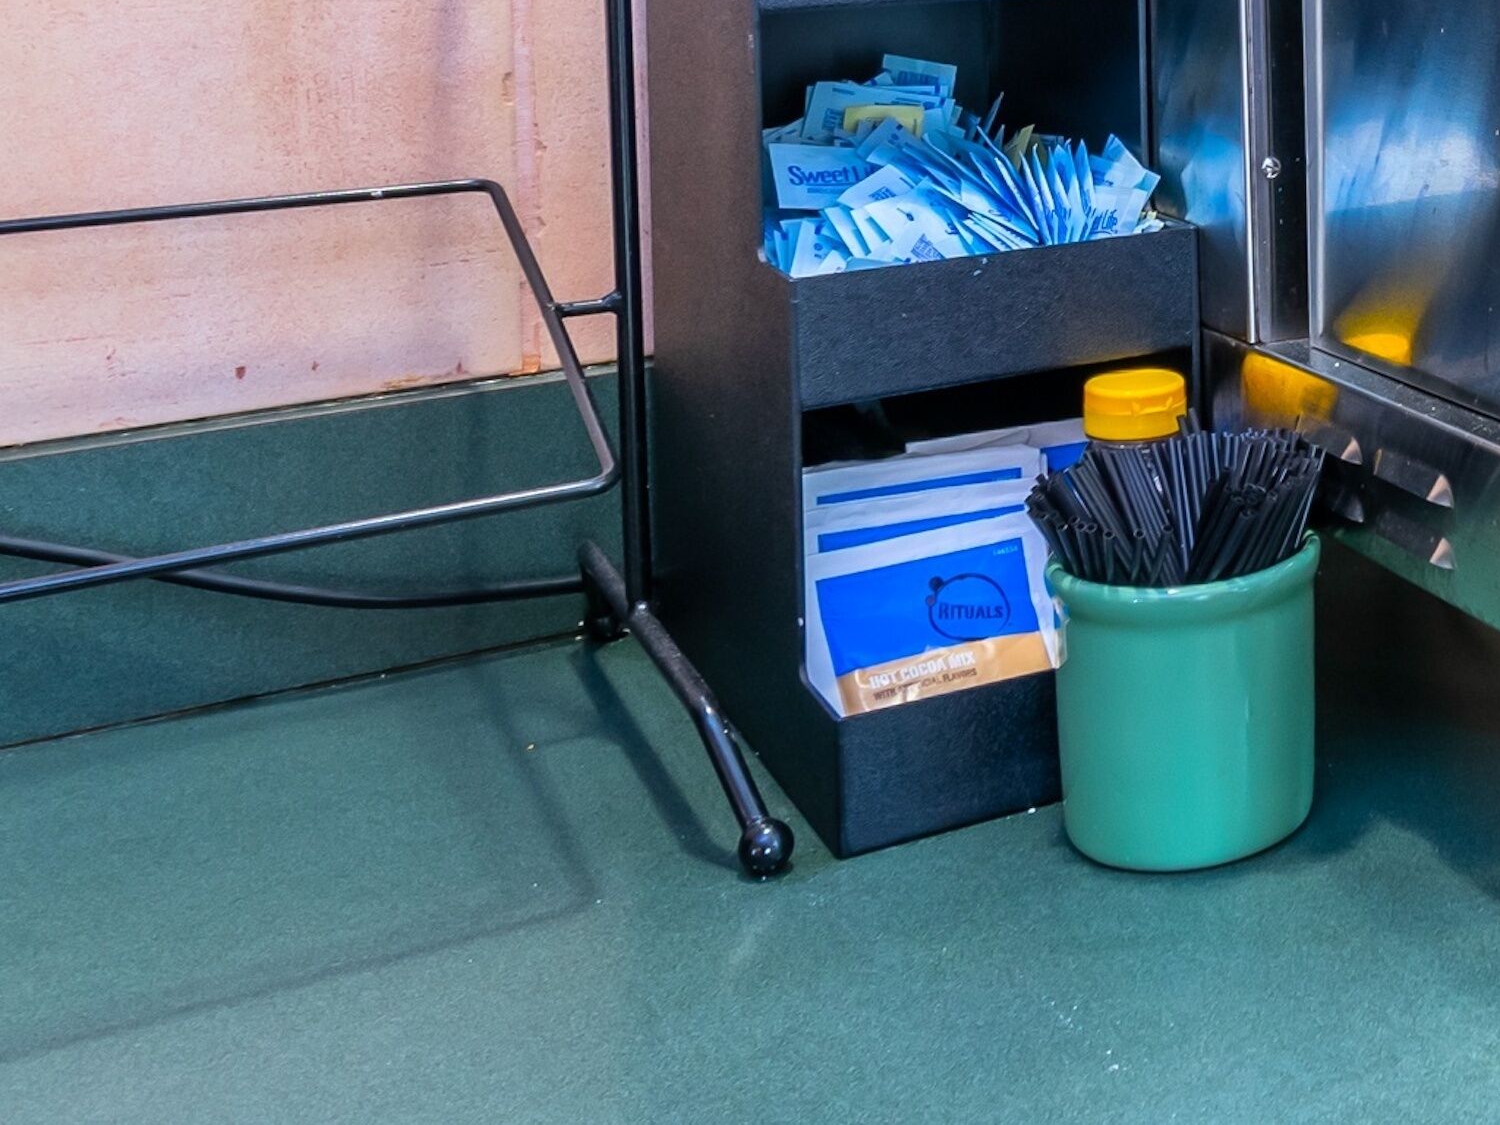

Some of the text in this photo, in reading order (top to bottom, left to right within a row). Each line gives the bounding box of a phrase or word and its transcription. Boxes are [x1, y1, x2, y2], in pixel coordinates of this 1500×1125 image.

[787, 165, 850, 186] Sweet
[938, 603, 1003, 620] RITUALS
[869, 672, 897, 689] HOT
[900, 658, 946, 680] COCOA
[948, 650, 977, 669] MIX
[943, 667, 977, 683] FLAVORS
